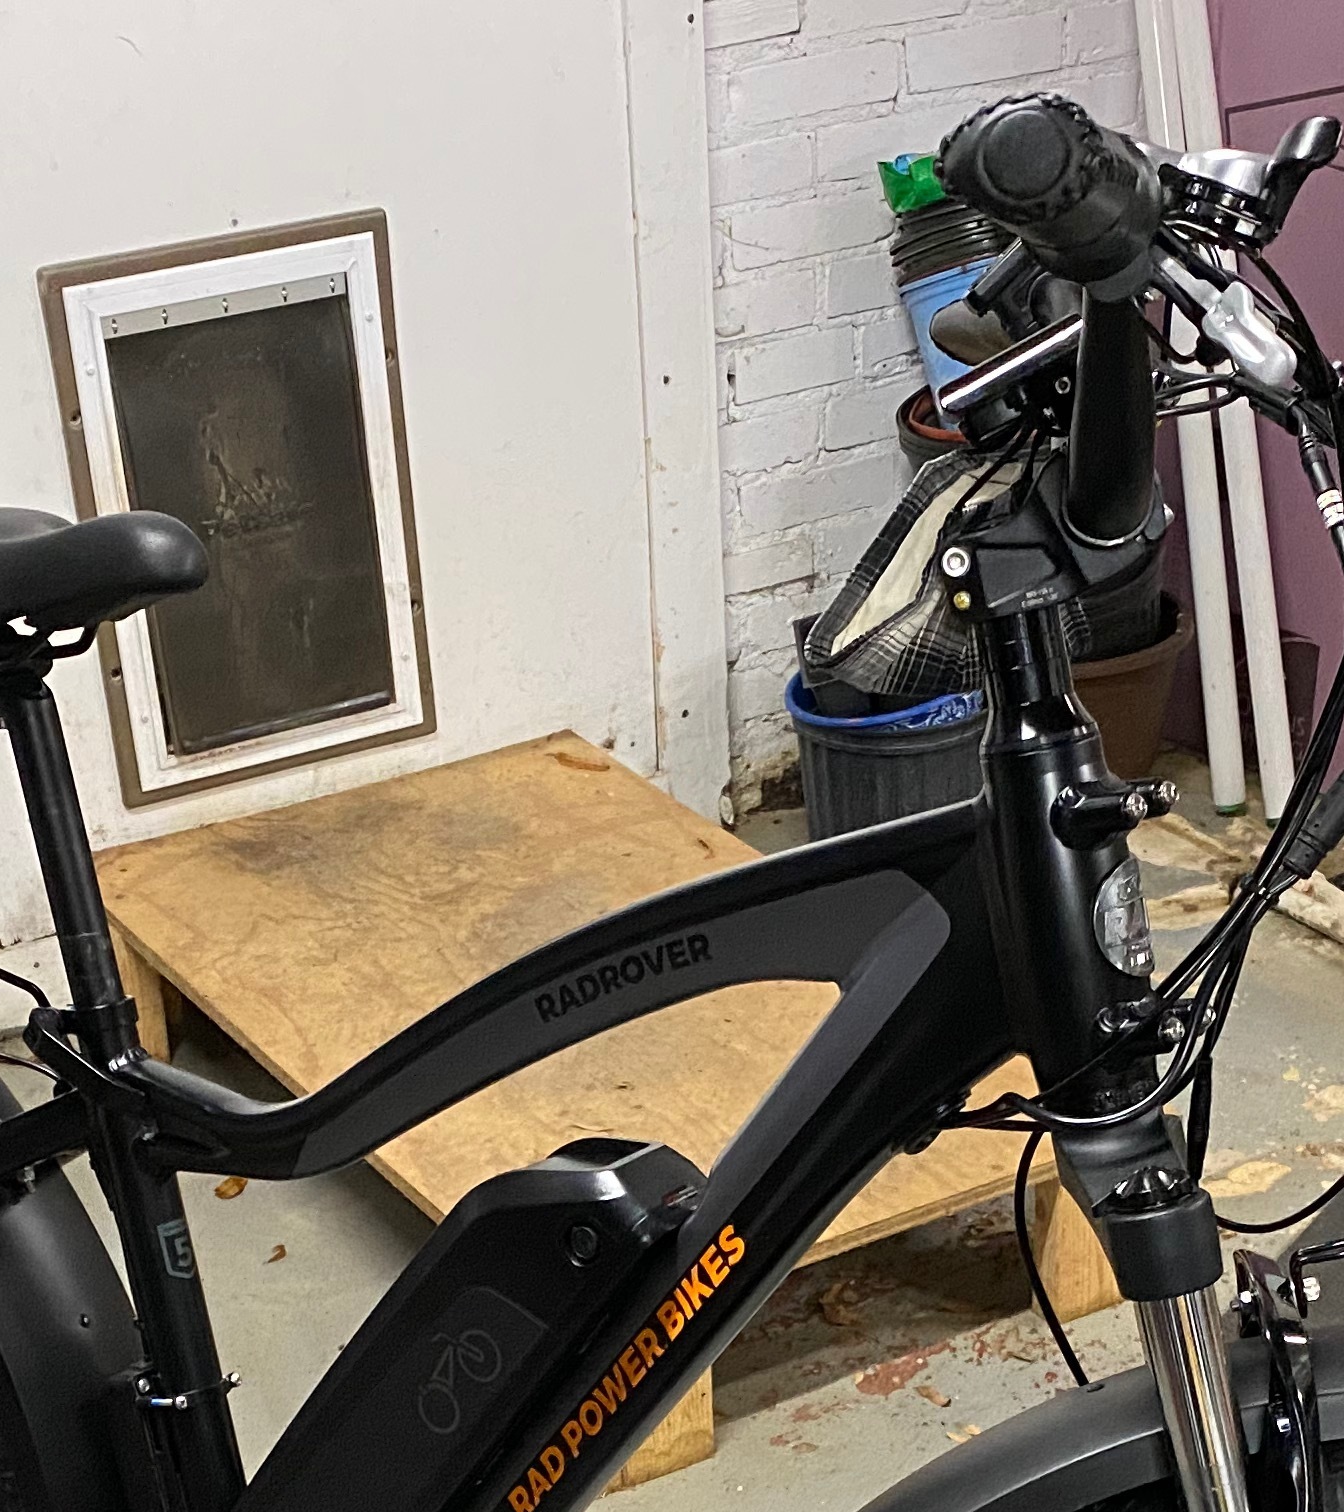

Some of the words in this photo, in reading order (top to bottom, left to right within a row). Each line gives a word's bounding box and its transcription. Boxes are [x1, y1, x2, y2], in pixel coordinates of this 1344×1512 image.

[534, 933, 712, 1023] RADROVER
[561, 1328, 665, 1456] POWER
[656, 1224, 746, 1342] BIKES
